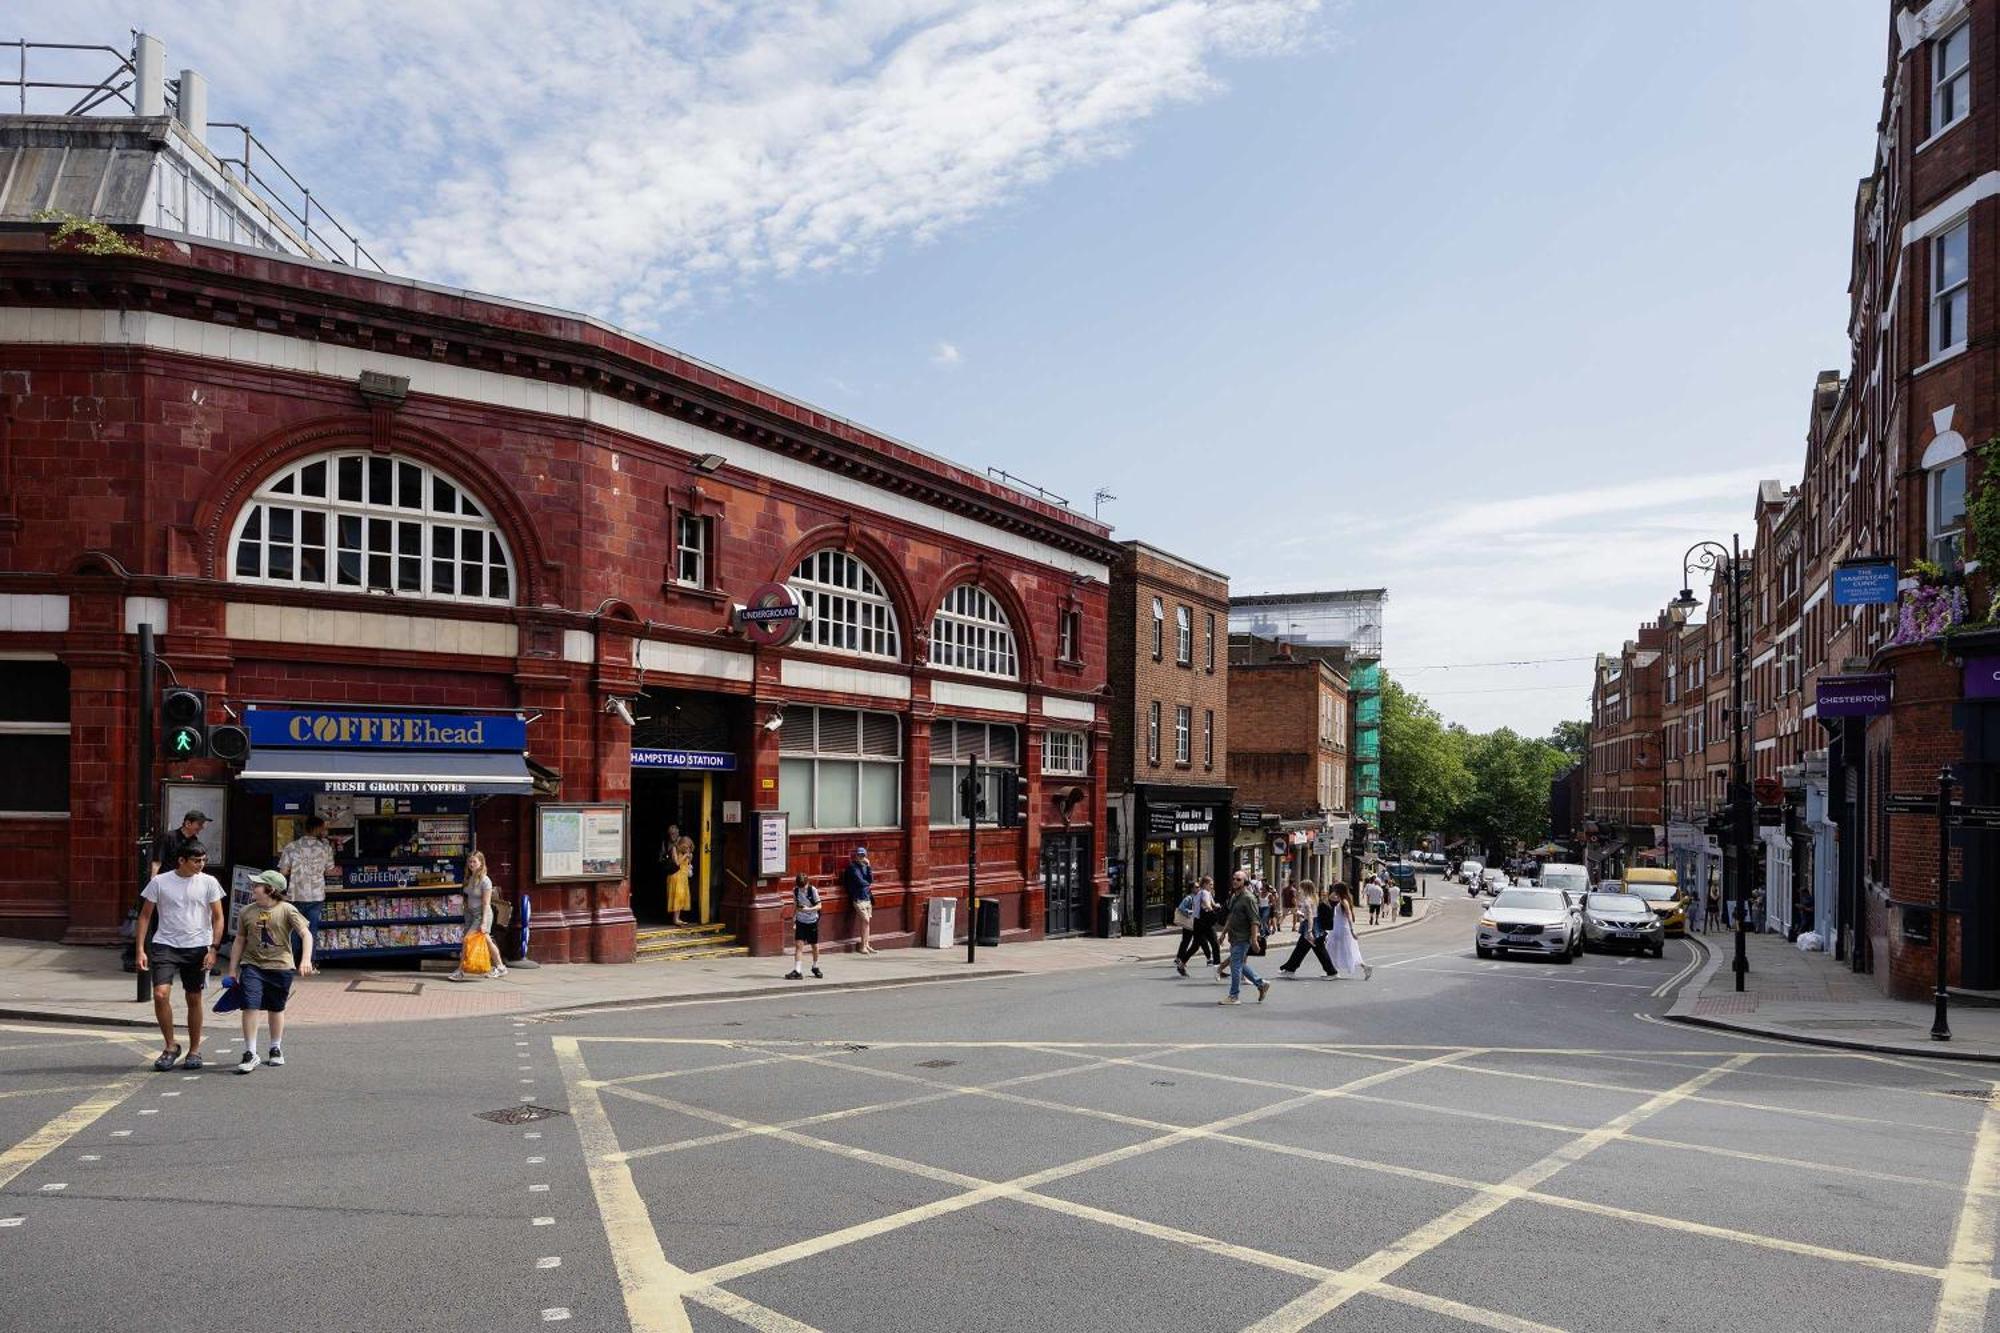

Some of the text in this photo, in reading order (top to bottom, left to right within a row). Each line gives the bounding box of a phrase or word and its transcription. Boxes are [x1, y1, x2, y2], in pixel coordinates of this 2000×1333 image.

[742, 607, 797, 619] UNDERGROUND
[1819, 695, 1887, 705] CHESTERTONS
[630, 752, 724, 766] HAMPSTEAD STATION
[324, 781, 466, 793] FRESH GROUND COFFEE
[1180, 820, 1211, 833] Company
